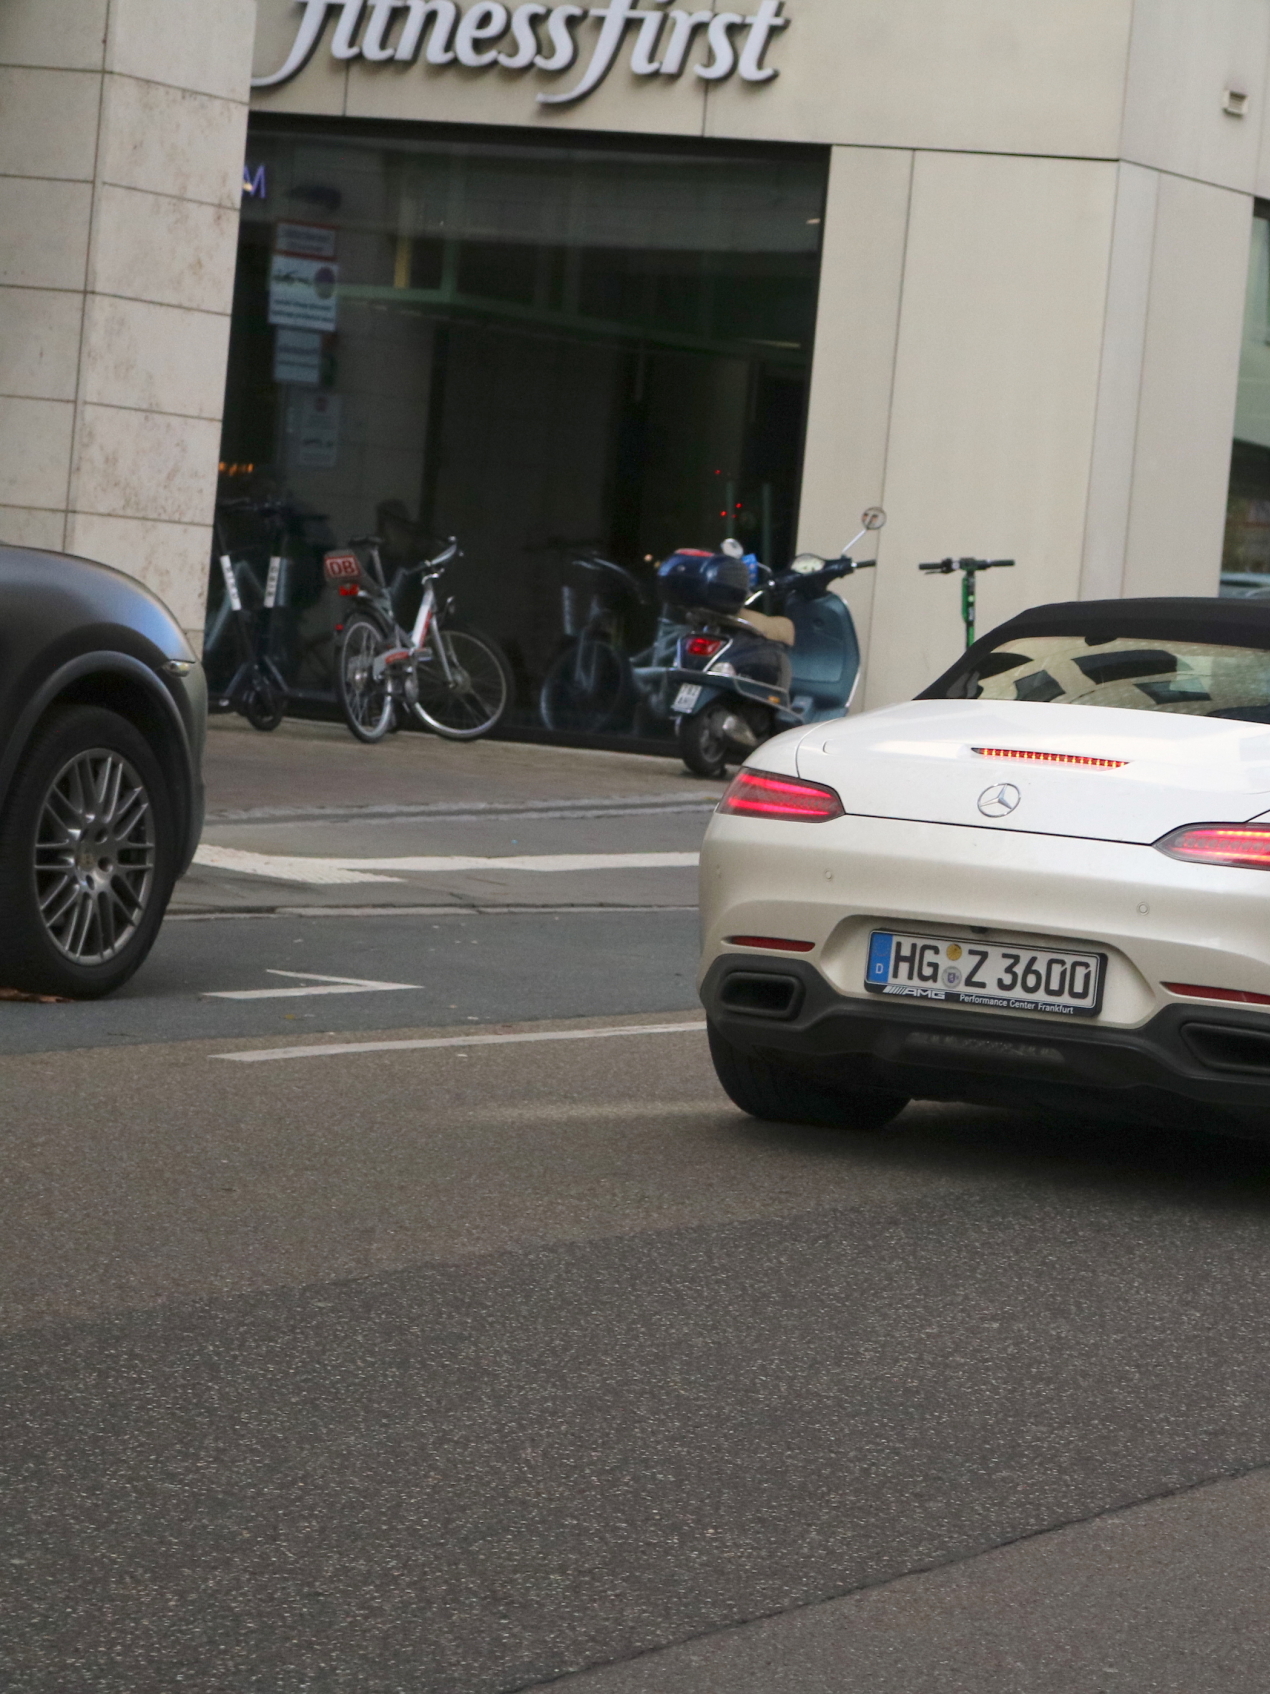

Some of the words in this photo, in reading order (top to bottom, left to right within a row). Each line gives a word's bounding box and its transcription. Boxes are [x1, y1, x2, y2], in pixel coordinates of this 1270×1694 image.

[329, 560, 355, 575] DB
[875, 963, 883, 974] D
[892, 941, 940, 983] HG
[964, 949, 989, 989] Z
[997, 953, 1092, 999] 3600
[900, 988, 945, 999] AMG
[959, 993, 1007, 1007] Performance
[1009, 1000, 1035, 1010] Center
[1037, 1002, 1074, 1014] Frankfurt
